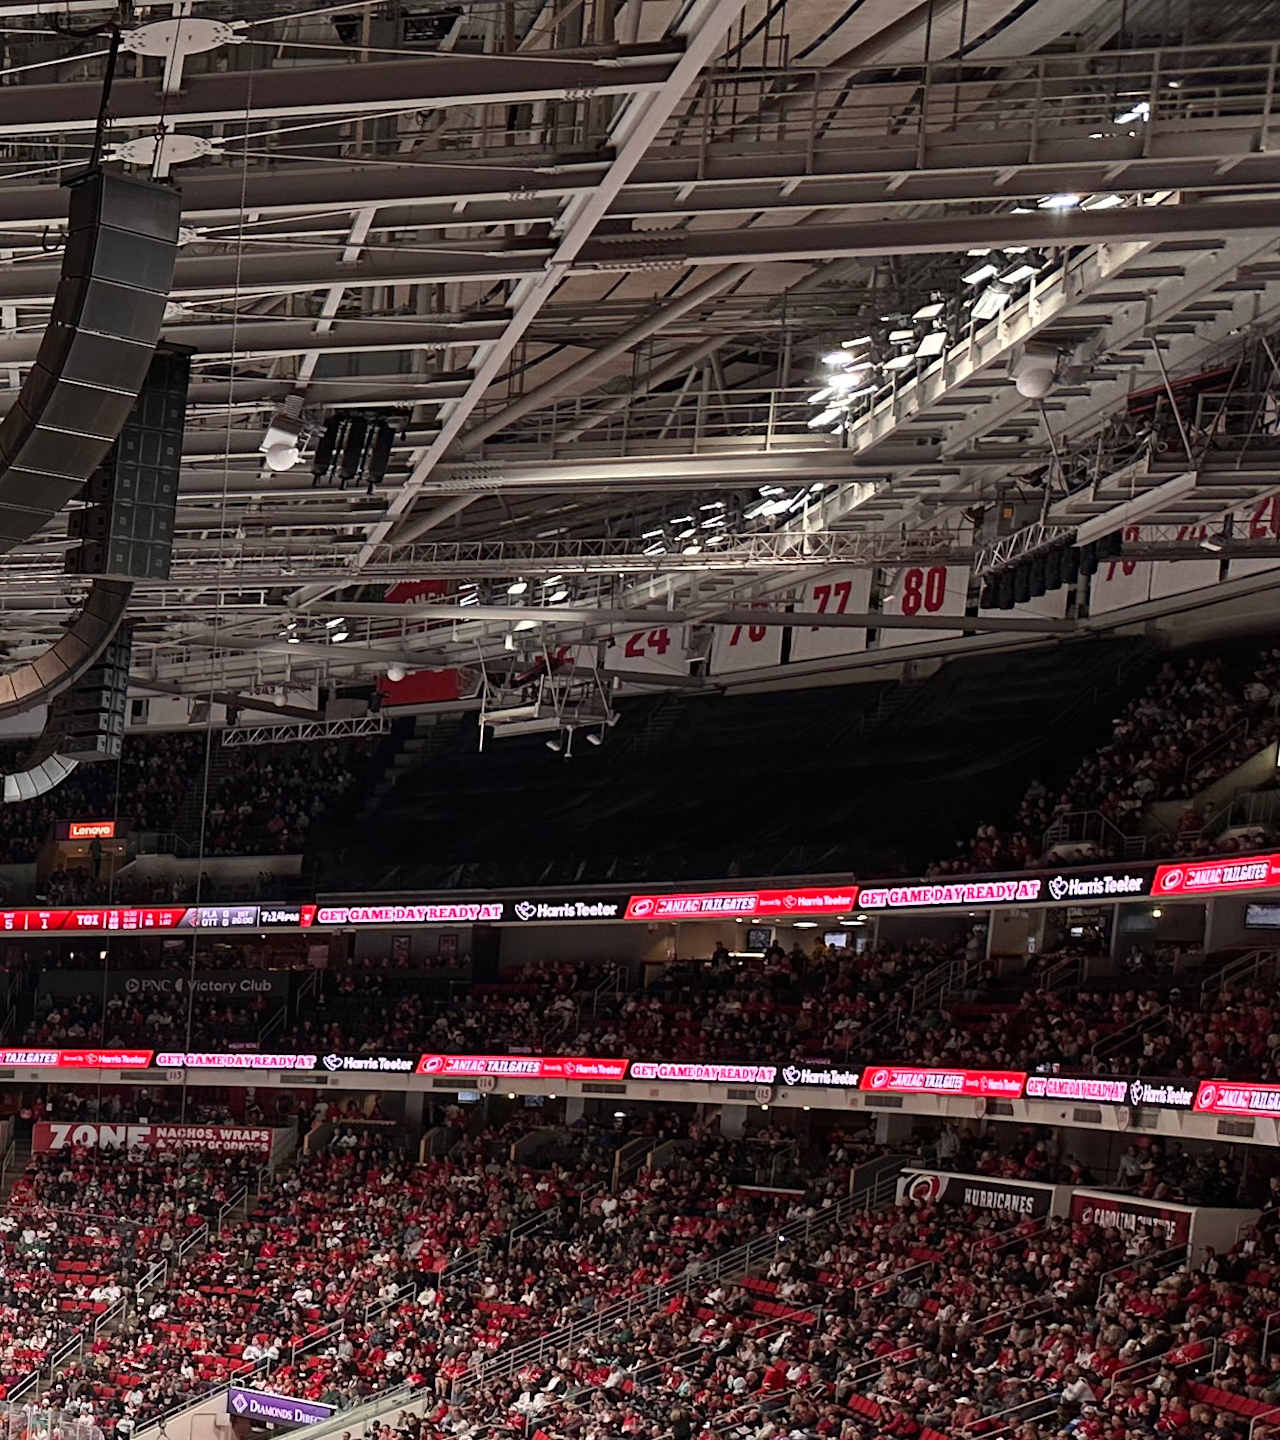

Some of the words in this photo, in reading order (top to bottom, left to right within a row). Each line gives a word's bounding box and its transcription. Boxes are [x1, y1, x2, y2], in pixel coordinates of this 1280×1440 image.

[902, 567, 946, 616] 80
[1068, 880, 1103, 895] Harris
[1104, 877, 1142, 894] Teeter
[317, 908, 347, 923] GET
[349, 908, 394, 922] GAME
[395, 906, 427, 921] DAY
[428, 905, 479, 920] READY
[479, 904, 503, 918] AT
[537, 904, 575, 918] Harris
[576, 902, 617, 917] Teeter
[142, 979, 170, 991] PNC
[188, 979, 236, 993] Victory
[240, 978, 271, 991] Club
[344, 1057, 377, 1070] Harris
[378, 1058, 413, 1071] Teeter
[50, 1125, 150, 1149] ZONE
[157, 1128, 216, 1139] NACHOS,
[221, 1129, 269, 1140] WRAPS
[964, 1188, 1034, 1213] HURRICANES
